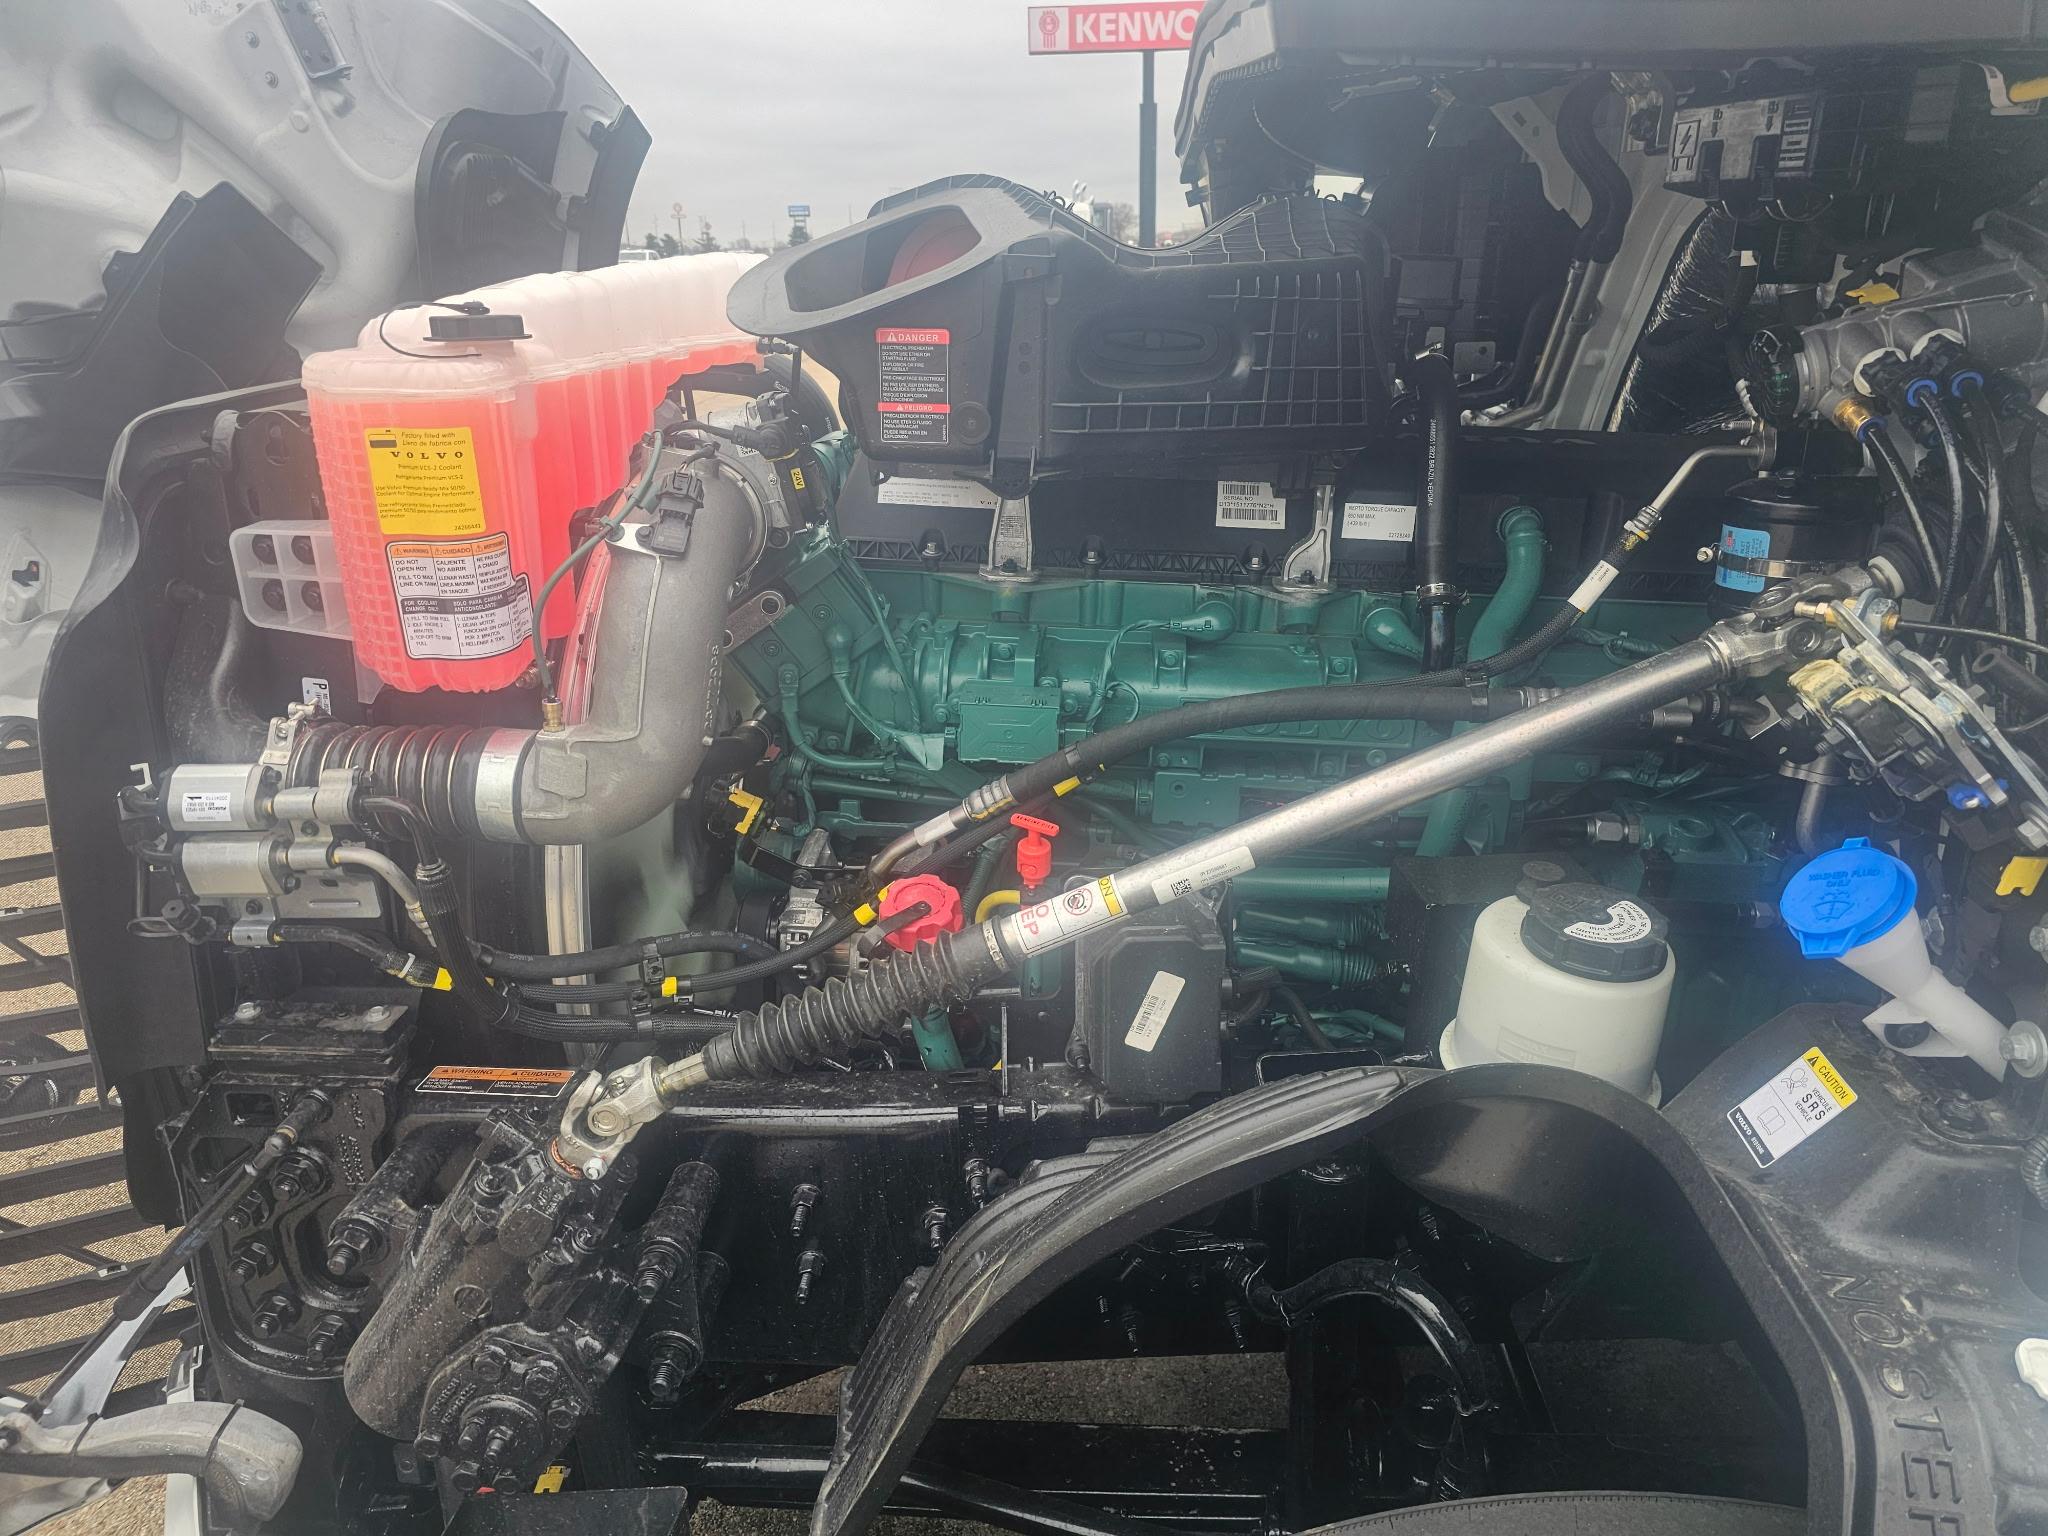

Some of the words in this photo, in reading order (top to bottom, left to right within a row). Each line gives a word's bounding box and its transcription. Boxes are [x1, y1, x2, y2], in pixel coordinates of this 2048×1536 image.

[1075, 8, 1199, 43] KENWO
[401, 432, 422, 440] Factory
[390, 451, 464, 459] VOLVO
[1427, 459, 1435, 482] BRAZIL
[442, 547, 471, 555] CUIDADO
[1808, 871, 1849, 881] WASHER
[1851, 868, 1881, 878] FLUID
[1818, 1065, 1847, 1100] CAUTION
[1795, 1100, 1813, 1123] VEHICLE
[1801, 1093, 1826, 1121] SRS
[1735, 1111, 1753, 1136] VOLVO
[1821, 1271, 1905, 1345] NO
